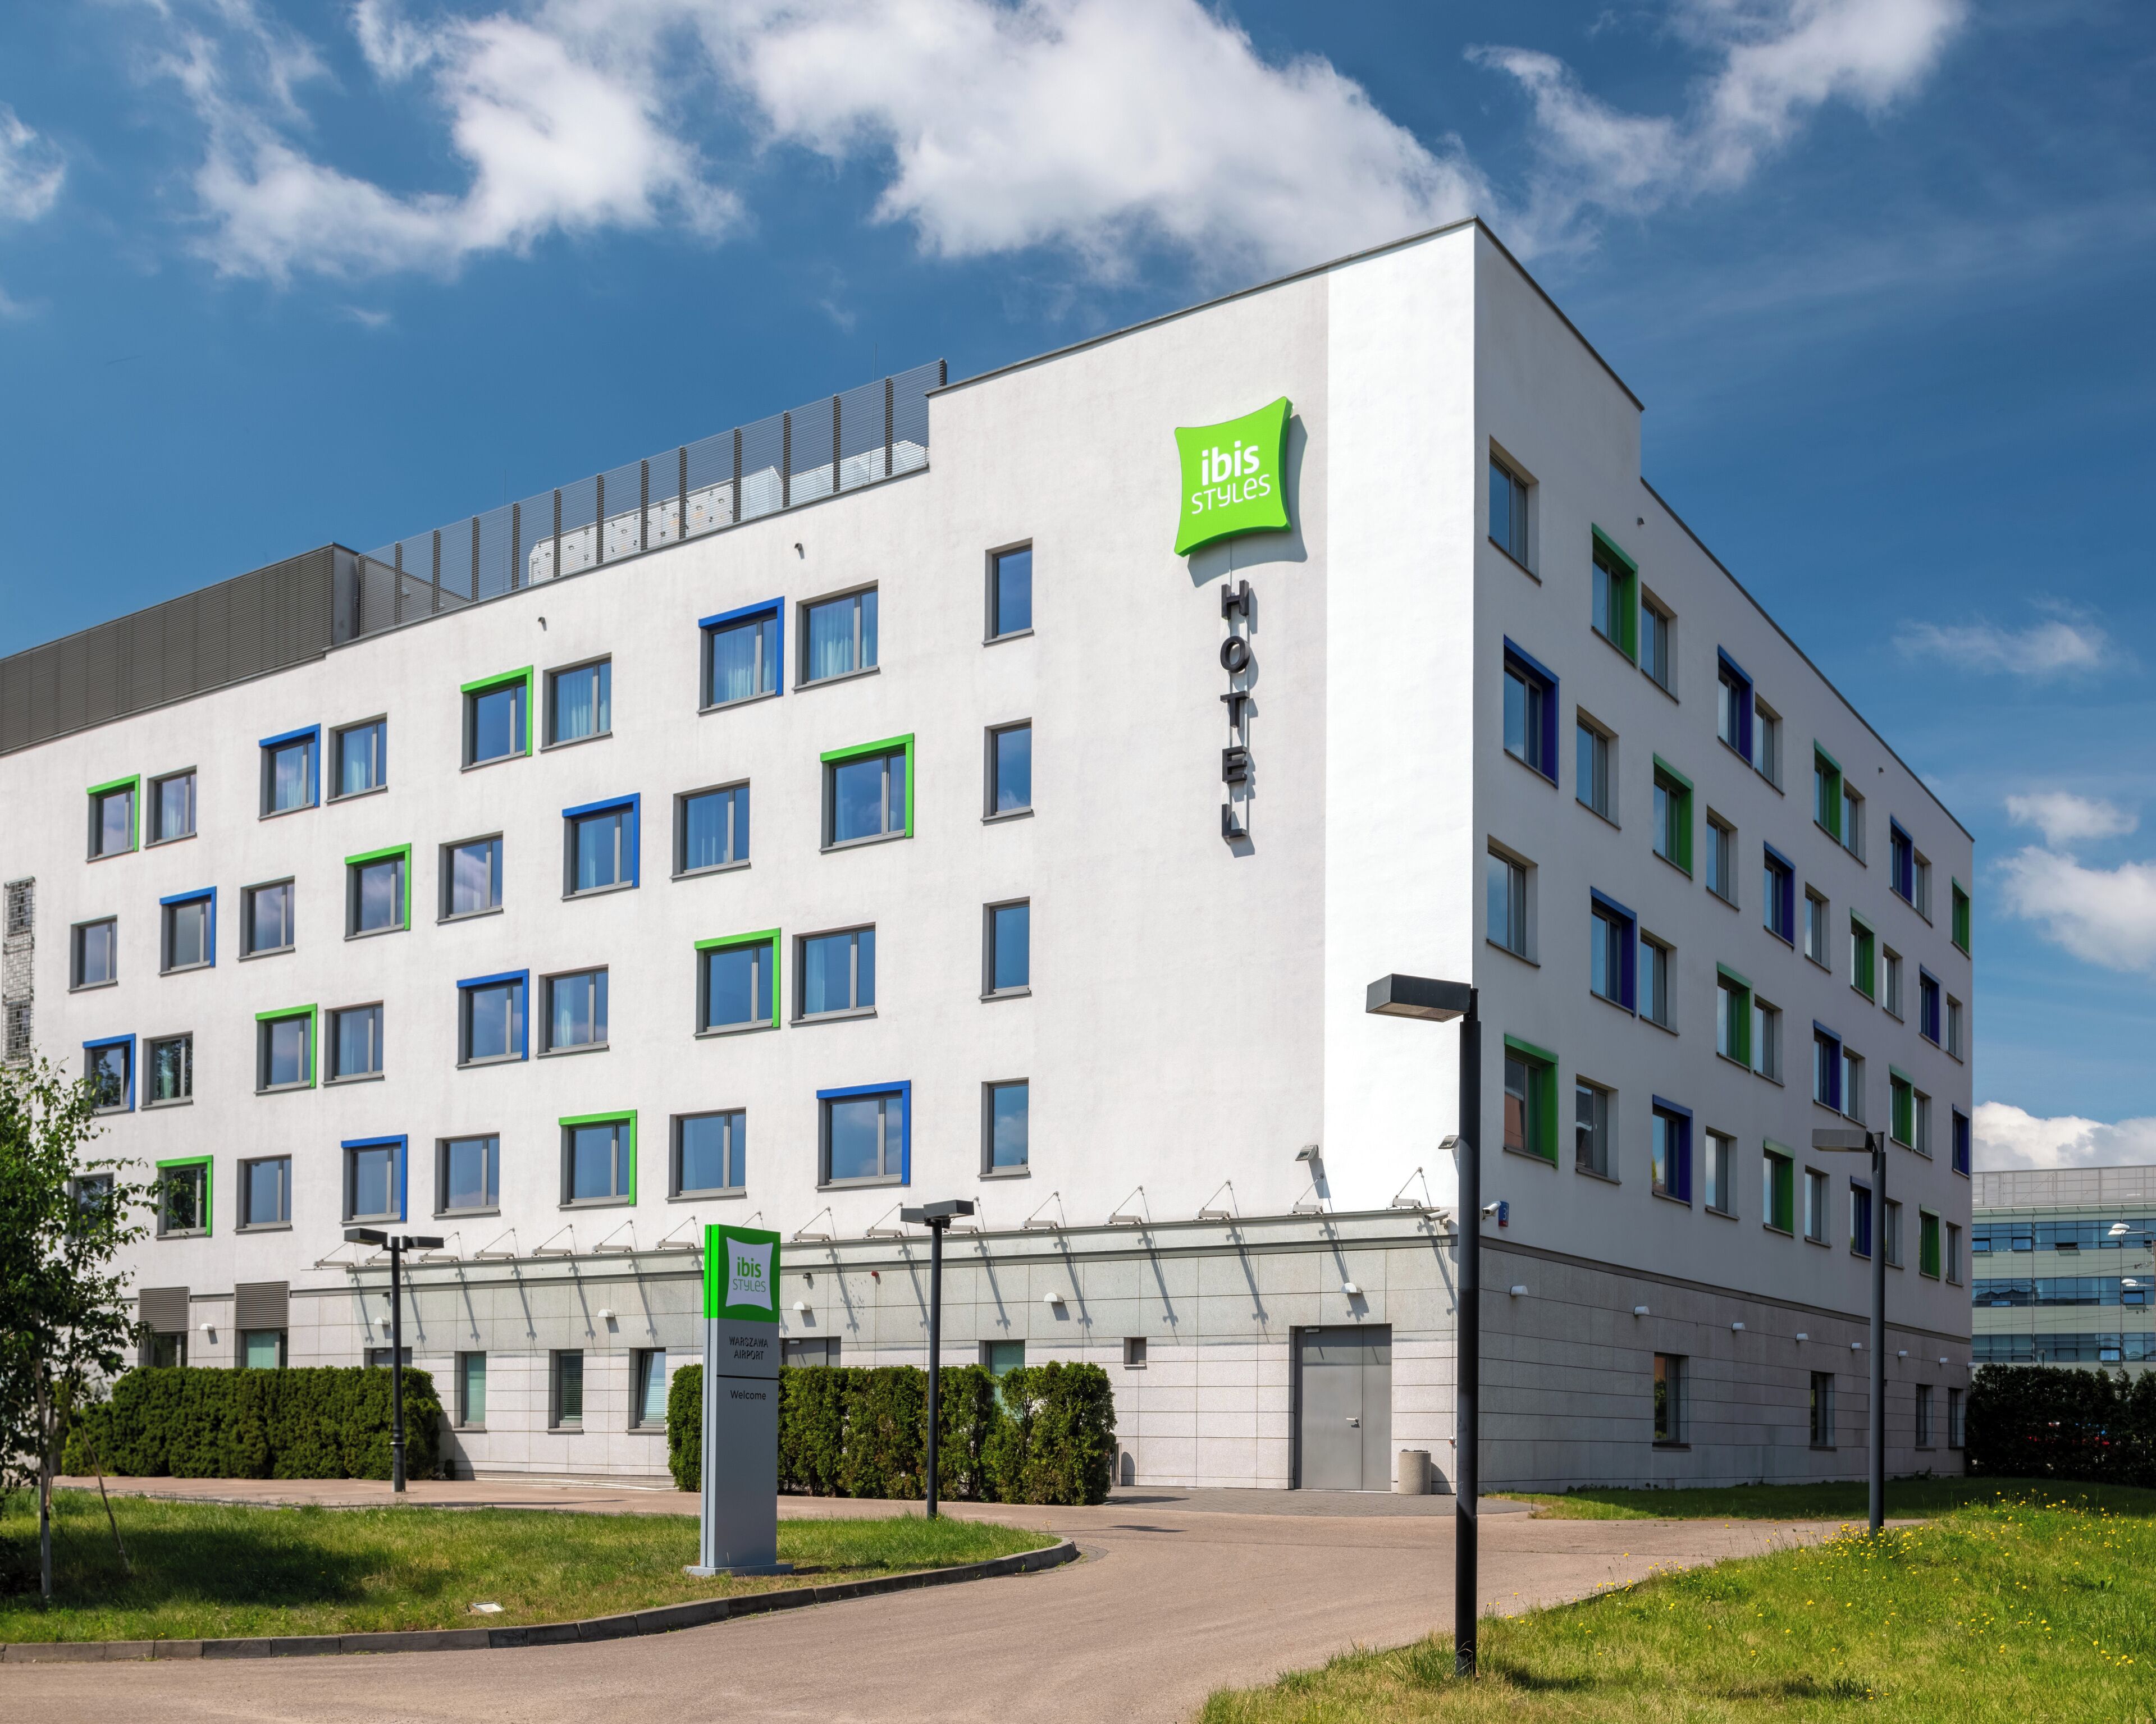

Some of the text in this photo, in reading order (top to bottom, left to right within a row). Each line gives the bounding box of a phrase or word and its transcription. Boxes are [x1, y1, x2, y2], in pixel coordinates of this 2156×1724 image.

[1202, 440, 1260, 486] ibis
[1220, 579, 1250, 838] HOTEL
[737, 1256, 762, 1278] ibis
[729, 1336, 769, 1348] WARSZAWA
[734, 1350, 764, 1360] AIRPORT
[730, 1390, 766, 1400] Welcome
